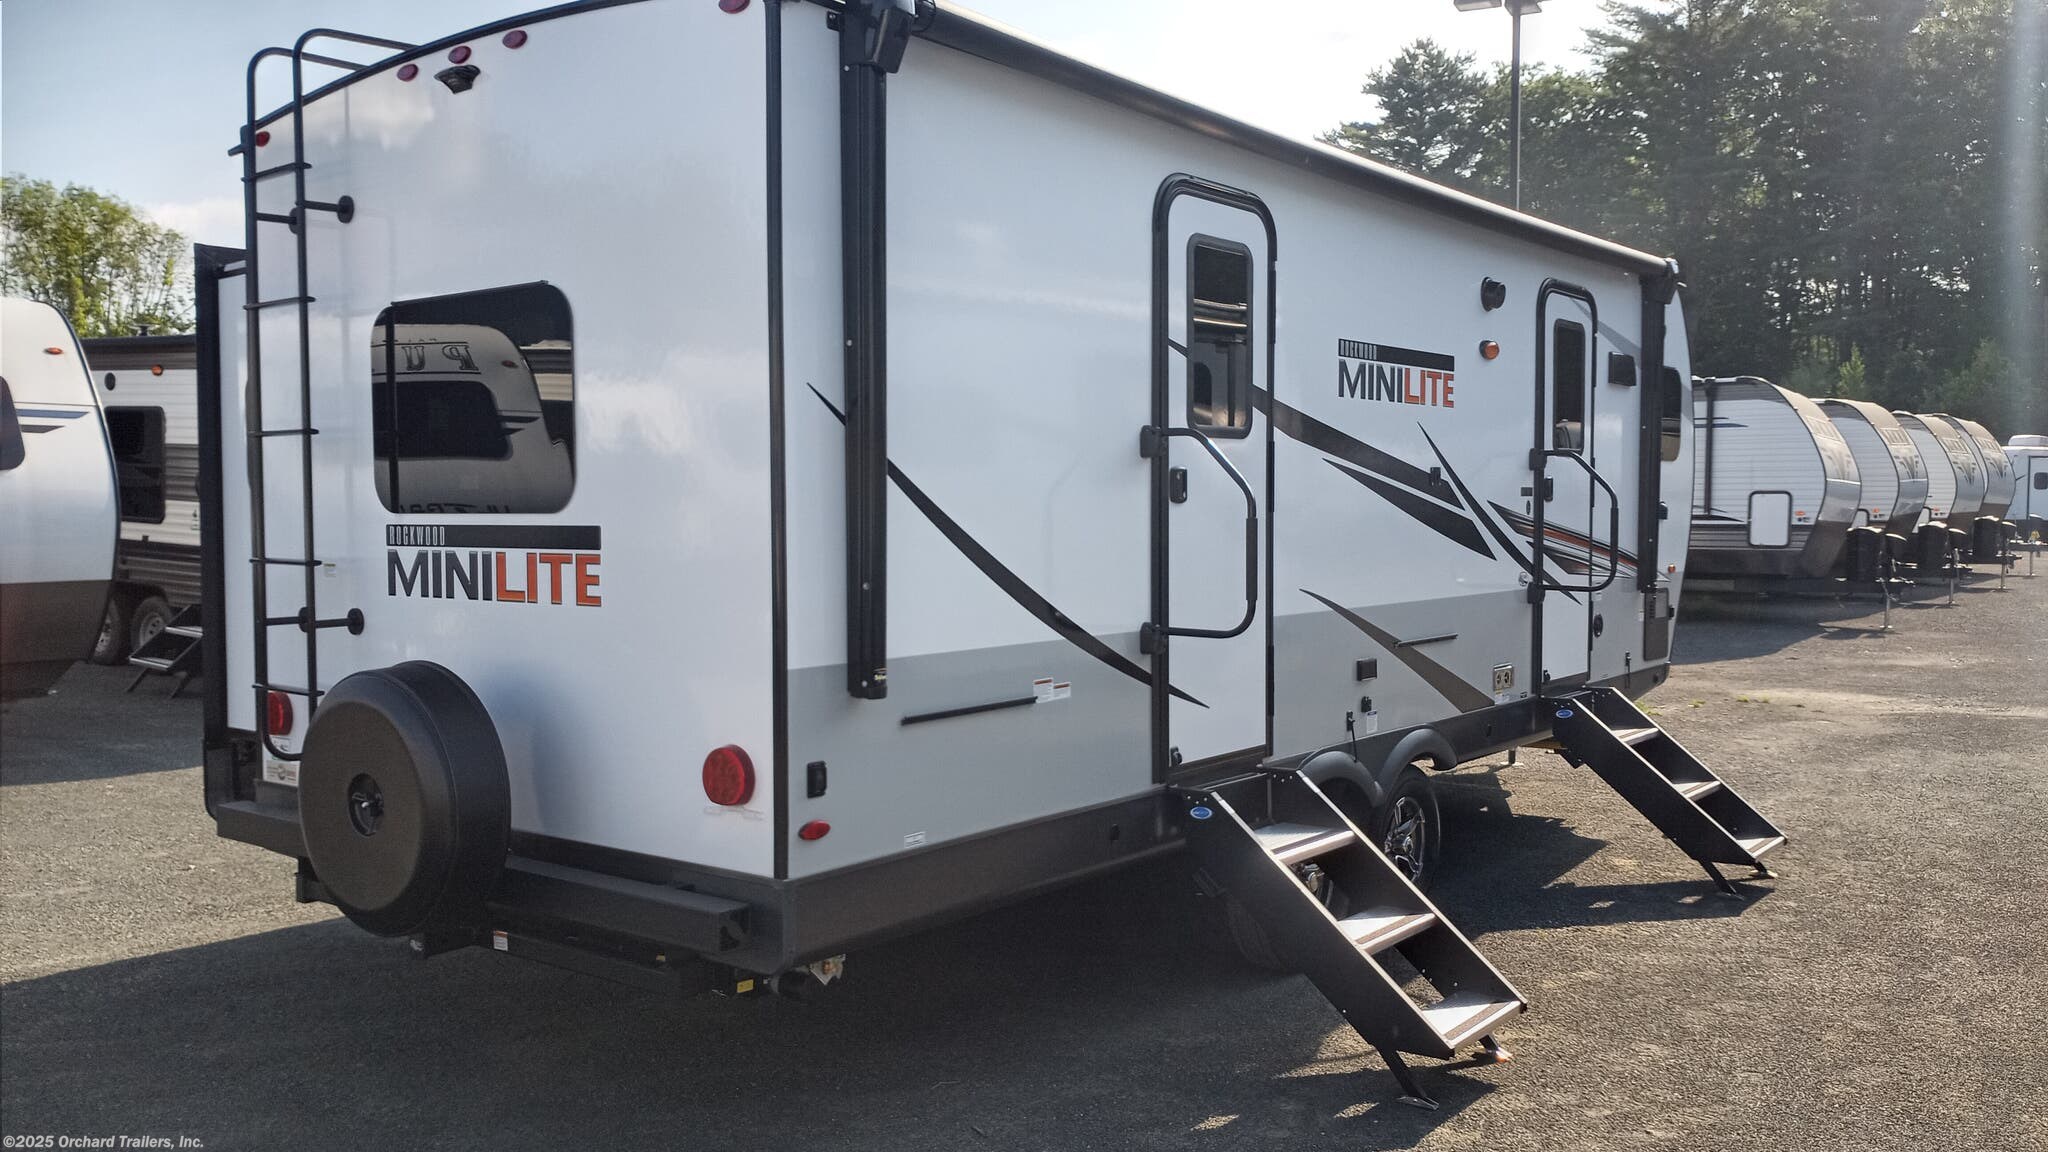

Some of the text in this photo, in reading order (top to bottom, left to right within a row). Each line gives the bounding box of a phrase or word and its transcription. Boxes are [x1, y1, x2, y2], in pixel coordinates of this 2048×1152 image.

[1338, 359, 1455, 408] MINILITE
[389, 526, 446, 546] ROCKWOOD
[387, 549, 602, 607] MINILITE
